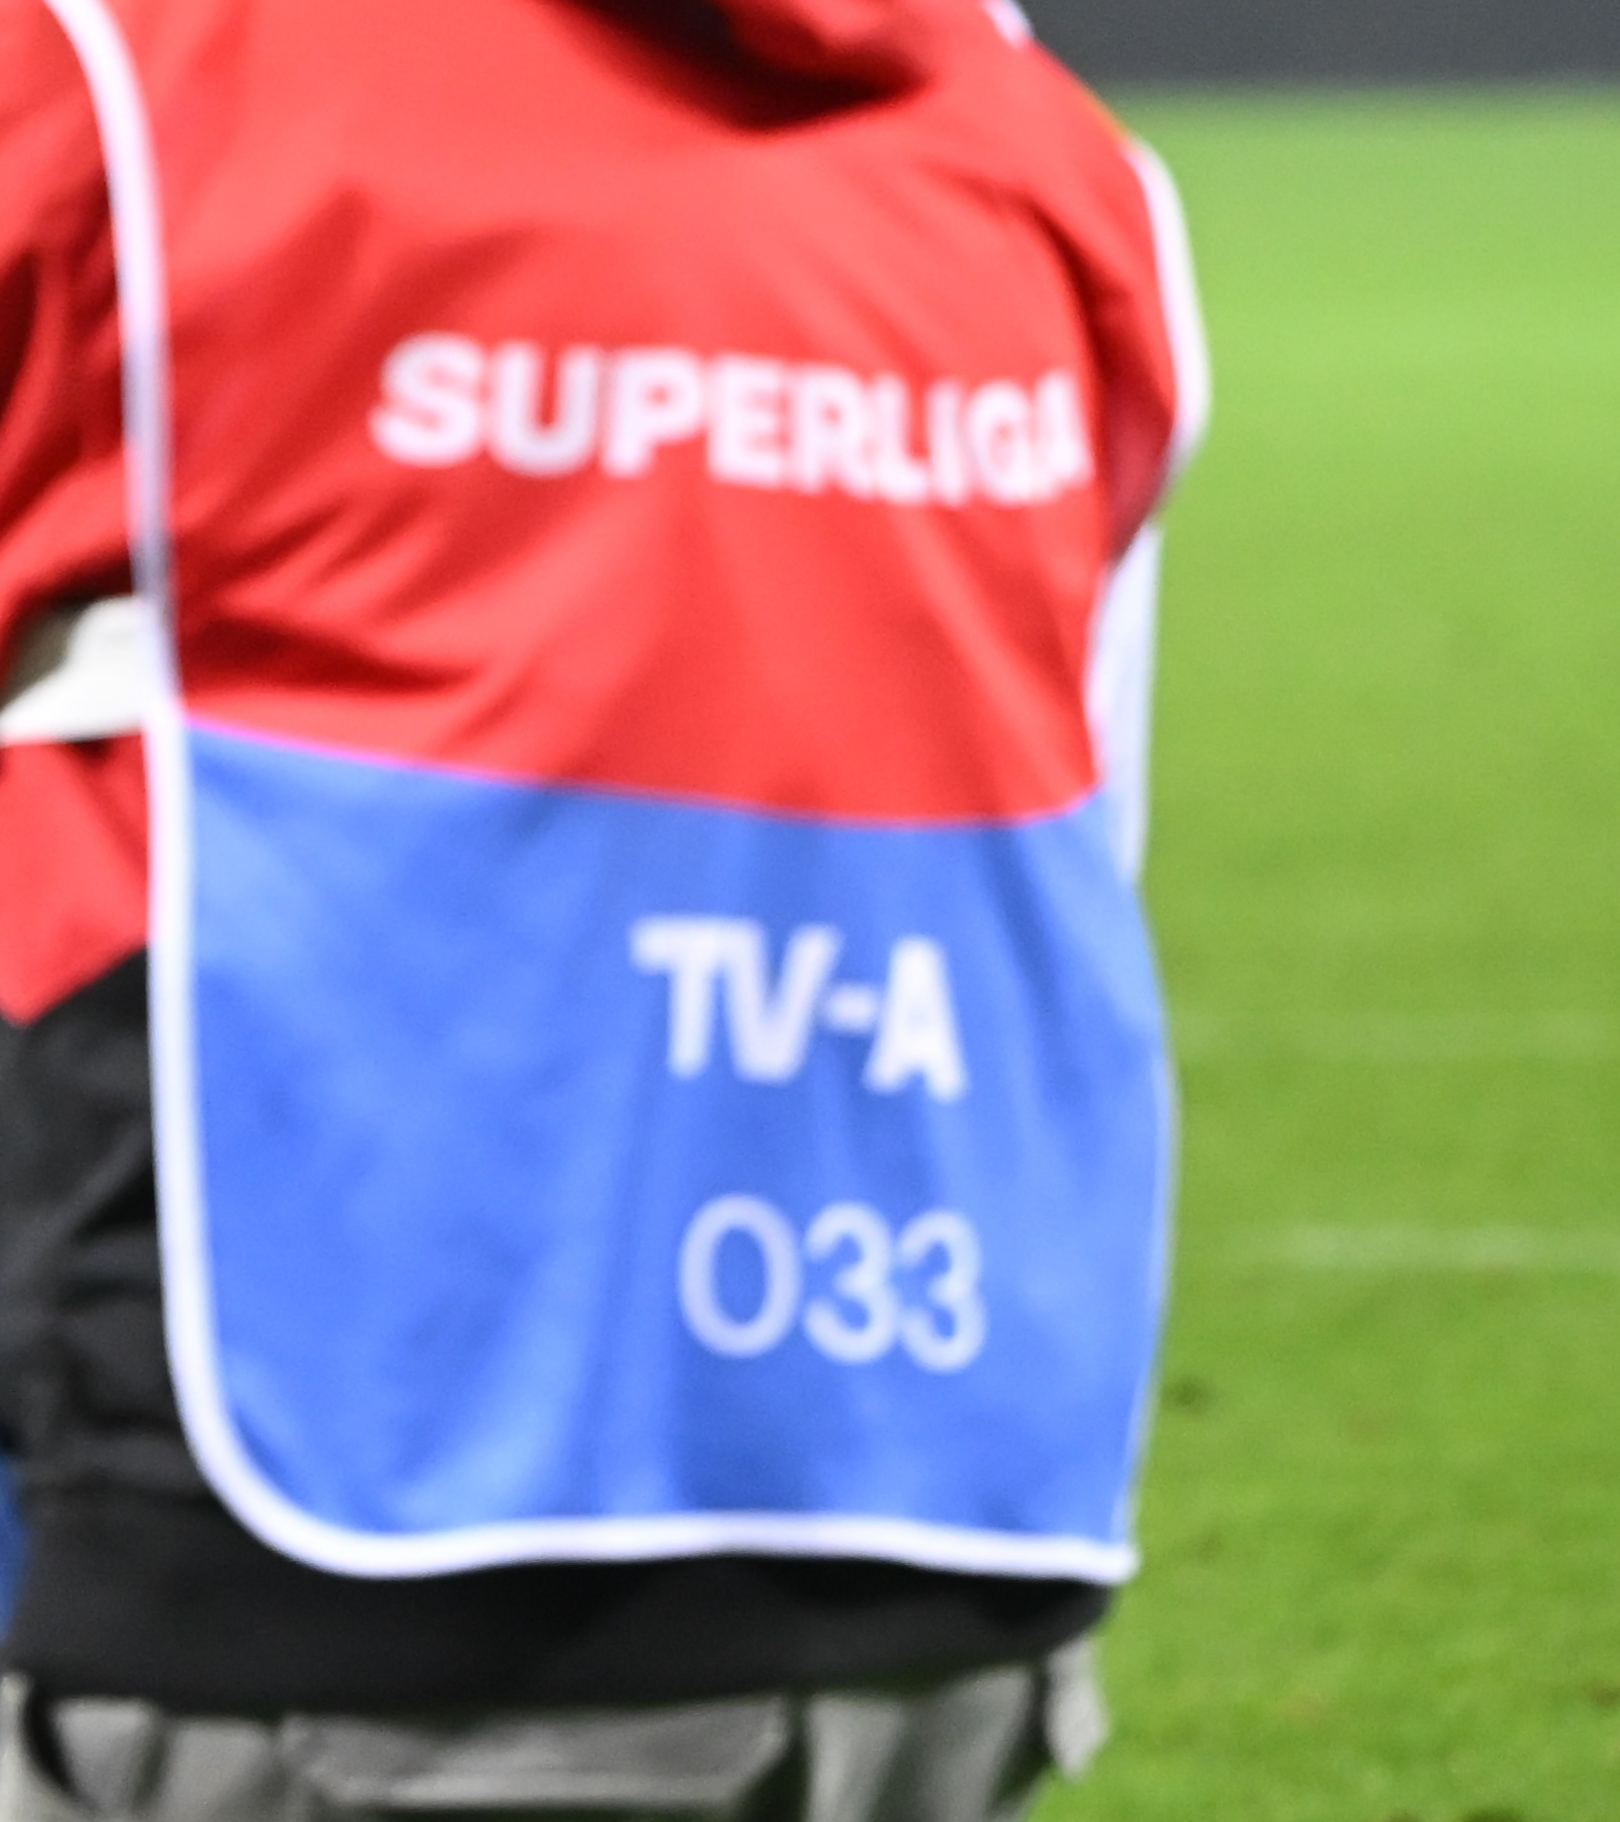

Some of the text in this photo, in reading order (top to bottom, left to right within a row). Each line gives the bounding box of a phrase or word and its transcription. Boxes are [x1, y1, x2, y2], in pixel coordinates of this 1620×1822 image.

[373, 335, 1091, 503] SUPERLIGA
[631, 916, 966, 1102] TV-A
[678, 1194, 987, 1372] 033
